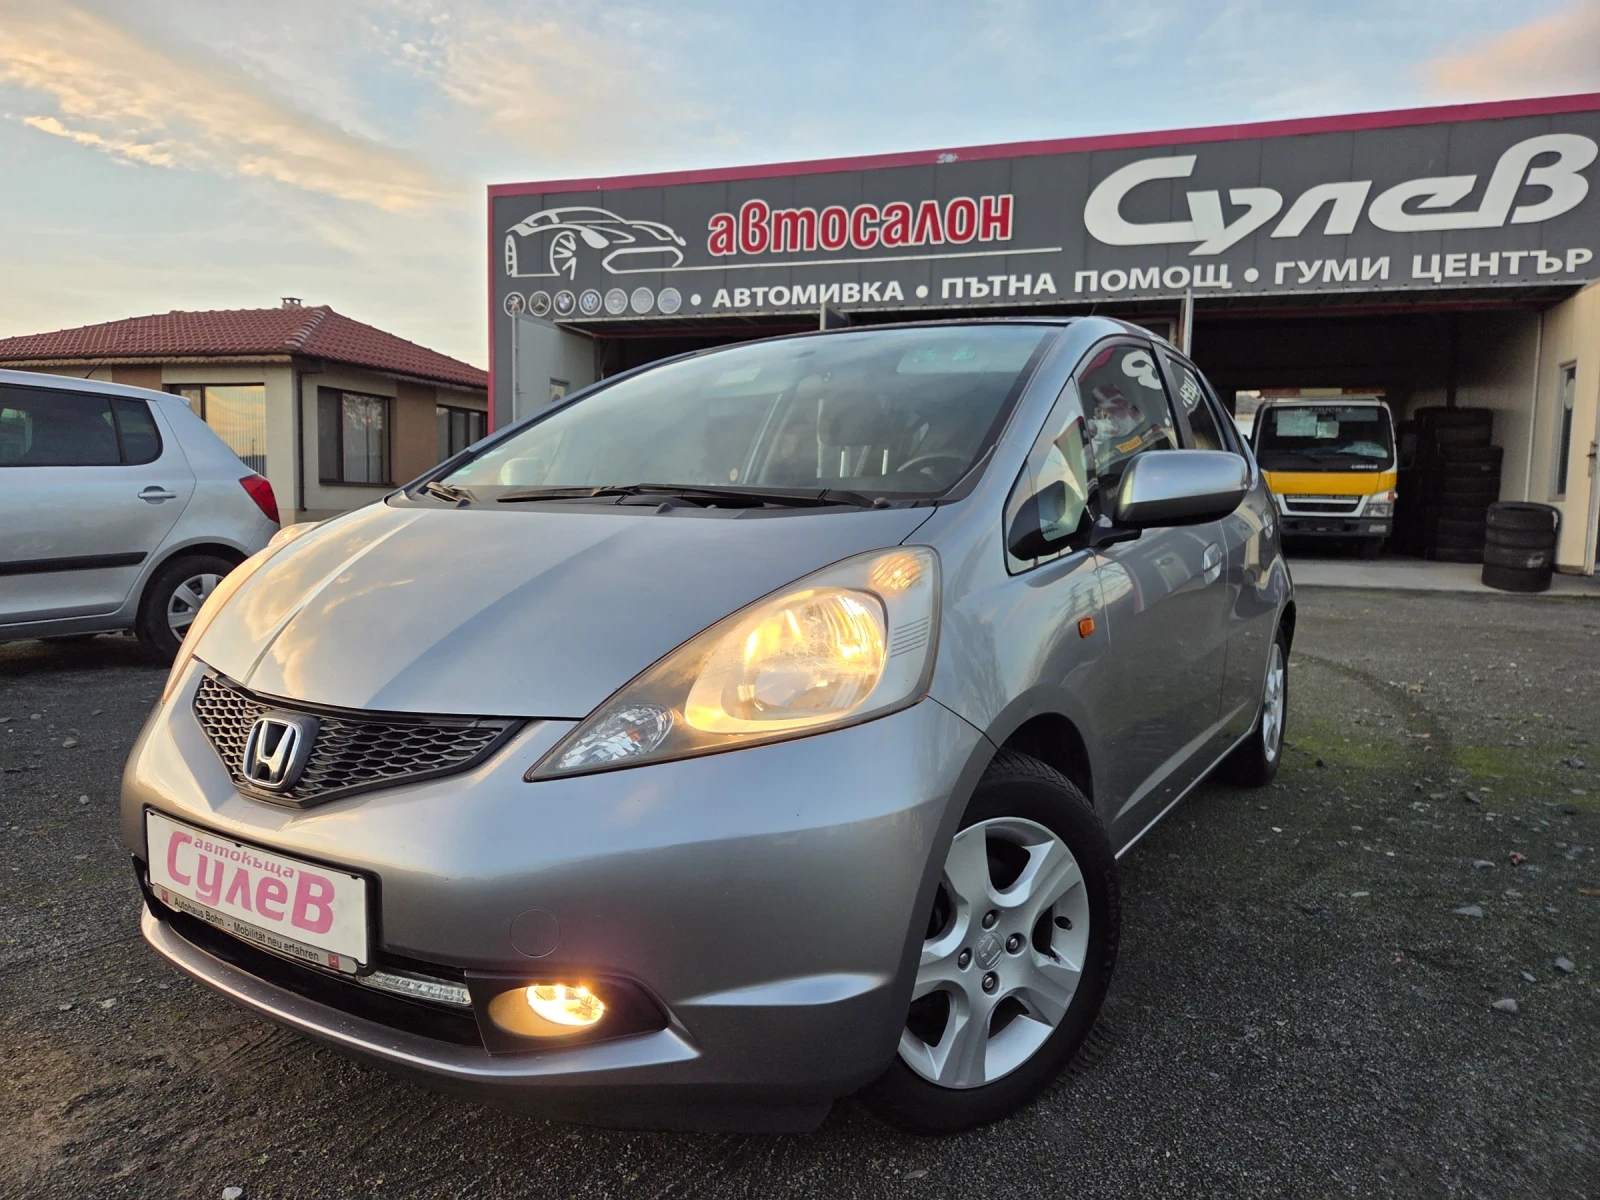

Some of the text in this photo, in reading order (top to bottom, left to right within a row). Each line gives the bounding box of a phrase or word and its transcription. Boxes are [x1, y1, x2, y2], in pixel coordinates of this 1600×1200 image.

[707, 194, 1013, 256] автосалон
[712, 247, 1594, 309] АВТОМИВКА ПЪТНА ПОМОЩ ГУМИ ЦЕНТЪР
[194, 837, 294, 879] автокъща
[174, 897, 204, 918] Autohaus
[205, 911, 224, 926] Bohn
[233, 922, 266, 941] Mobilität
[267, 936, 282, 949] neu
[283, 942, 319, 962] erfahren
